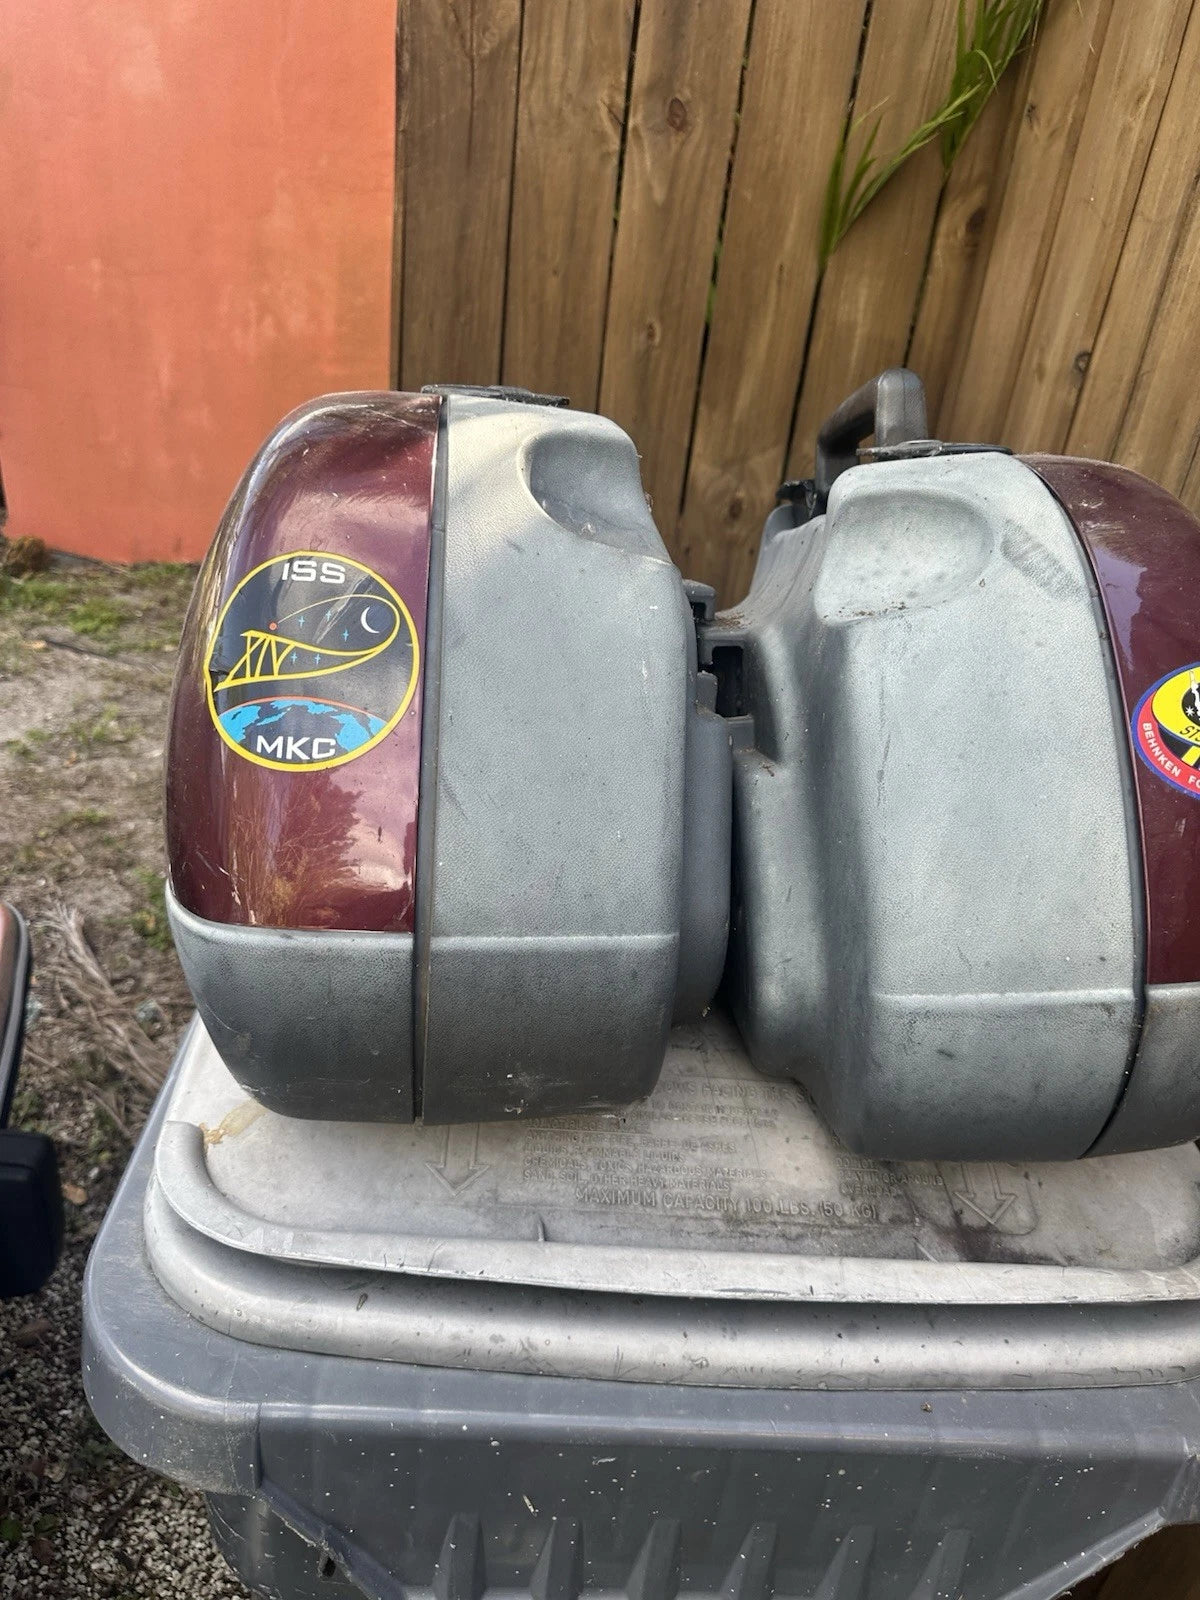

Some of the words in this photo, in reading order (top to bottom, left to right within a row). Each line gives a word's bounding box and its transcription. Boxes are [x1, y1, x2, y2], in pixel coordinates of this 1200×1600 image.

[281, 559, 346, 584] ISS
[256, 734, 337, 760] MKC
[1143, 722, 1181, 777] BEHNKEN
[590, 1173, 627, 1186] OTHER
[668, 1178, 731, 1192] MATERIALS
[575, 1187, 657, 1208] MAXIMUM
[662, 1191, 739, 1211] CAPACITY
[745, 1197, 773, 1214] 100
